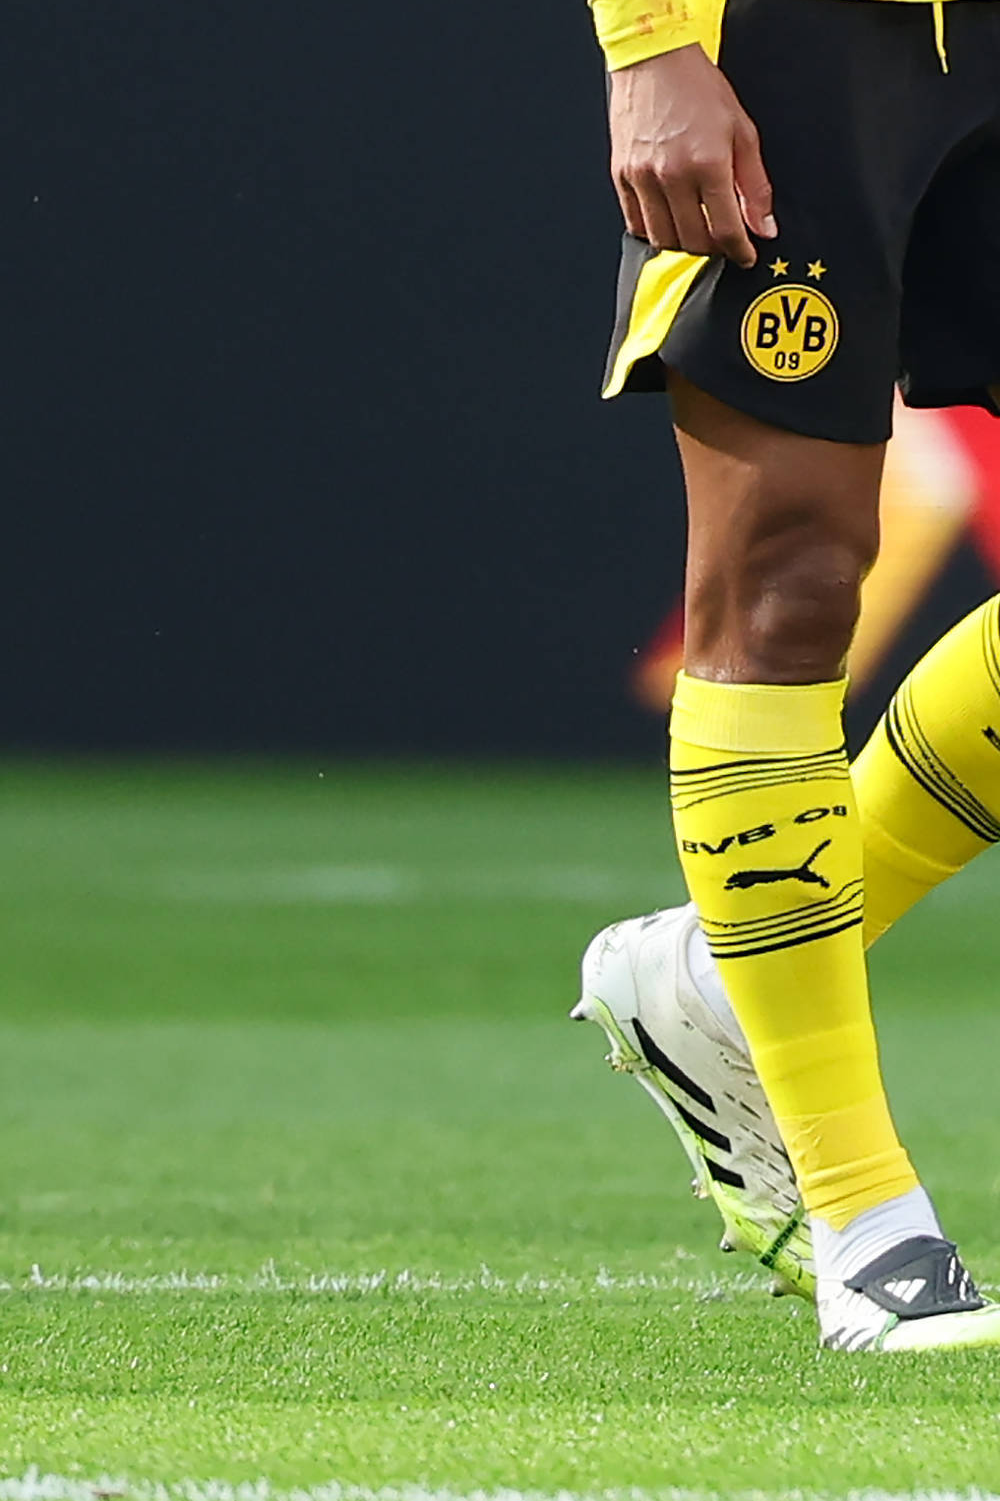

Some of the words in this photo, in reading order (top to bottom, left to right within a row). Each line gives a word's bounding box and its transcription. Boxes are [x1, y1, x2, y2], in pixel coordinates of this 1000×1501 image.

[755, 295, 828, 352] BVB
[774, 351, 800, 370] 09
[682, 823, 776, 855] BVB
